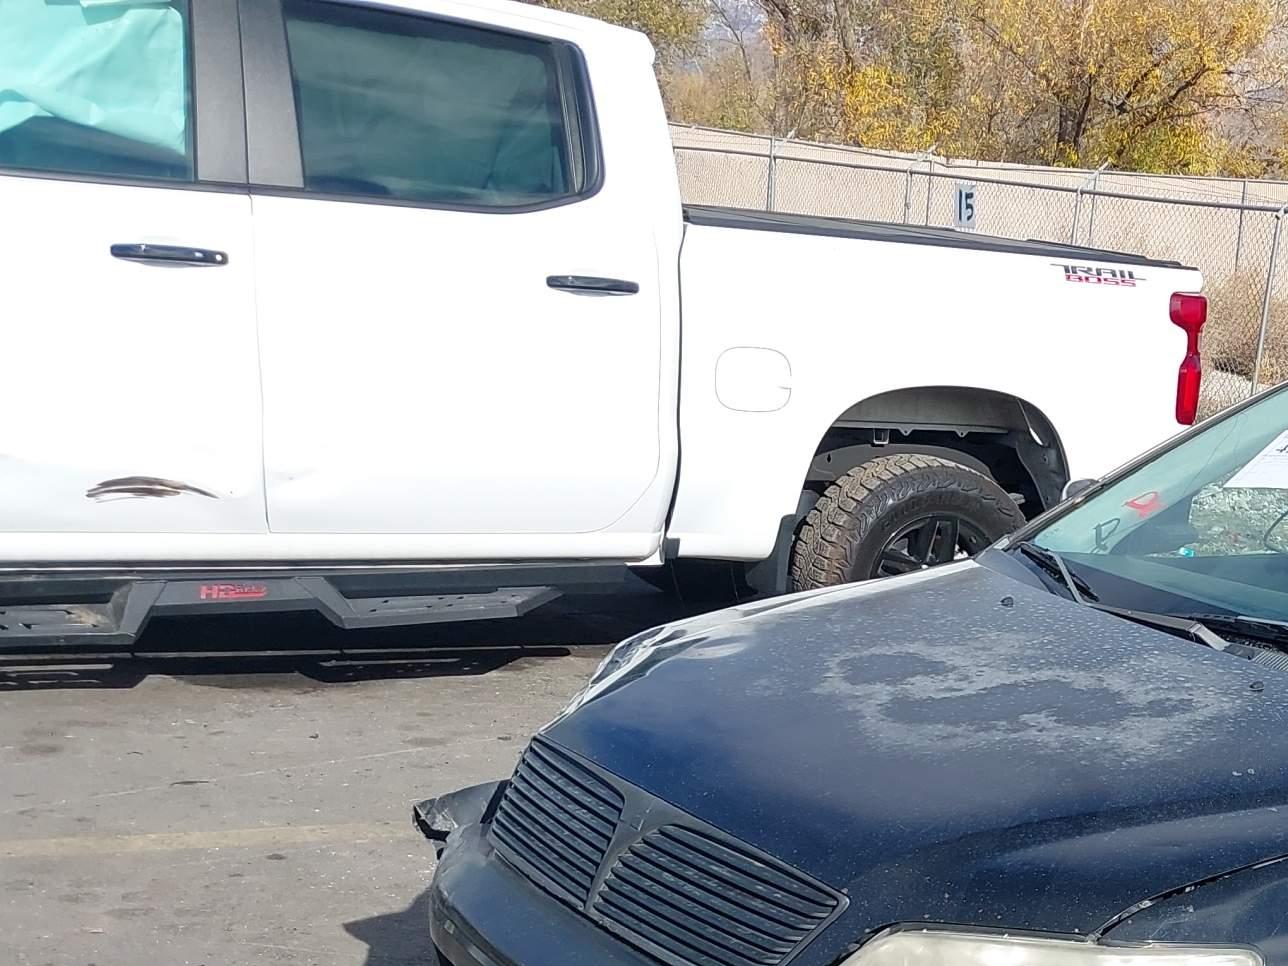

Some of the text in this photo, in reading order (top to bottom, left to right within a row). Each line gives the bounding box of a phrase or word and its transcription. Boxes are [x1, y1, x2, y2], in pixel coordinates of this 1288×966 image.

[959, 189, 974, 222] 15
[1050, 263, 1147, 281] TRAIL
[1065, 274, 1137, 287] BOSS
